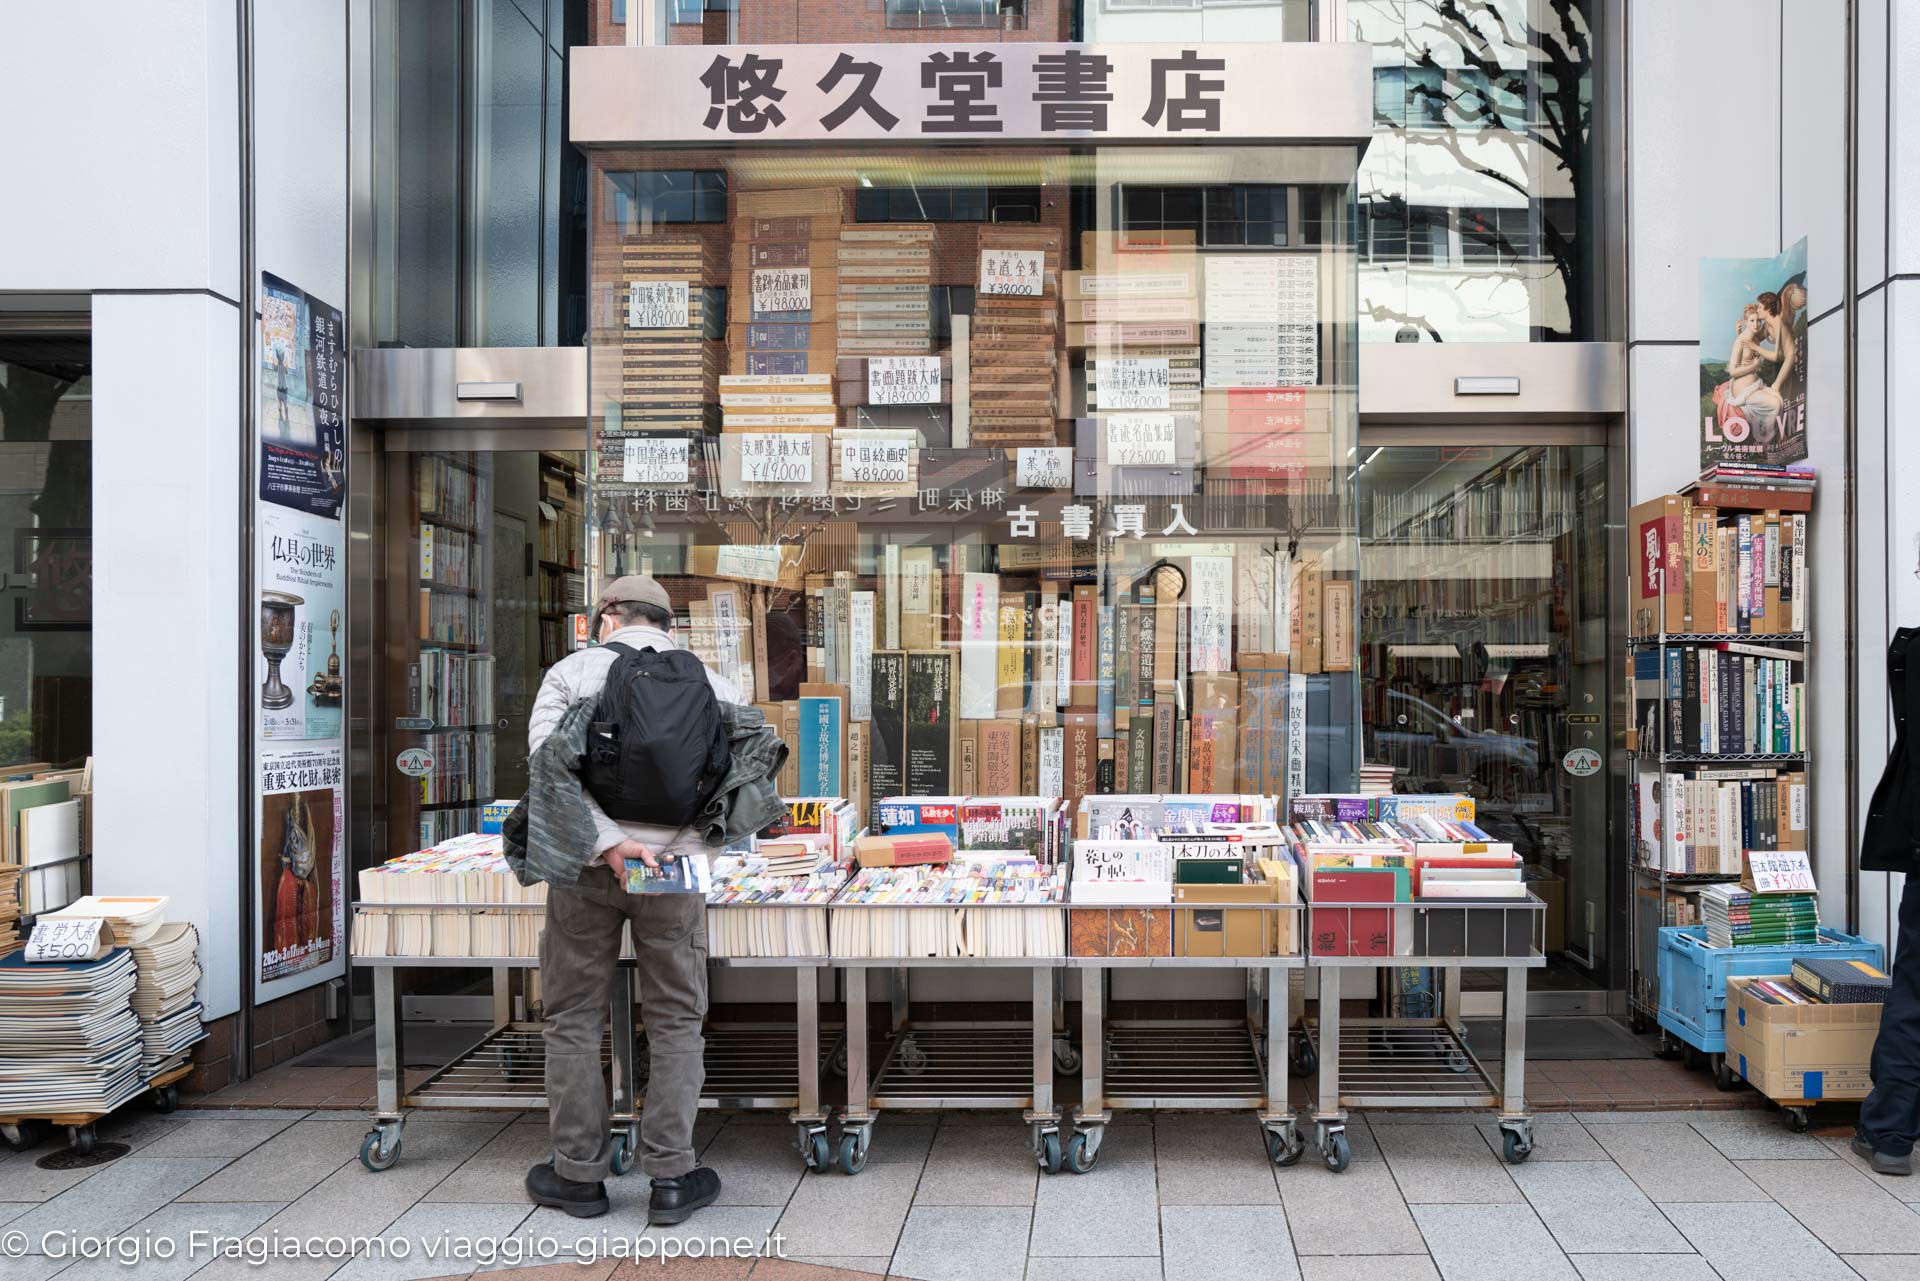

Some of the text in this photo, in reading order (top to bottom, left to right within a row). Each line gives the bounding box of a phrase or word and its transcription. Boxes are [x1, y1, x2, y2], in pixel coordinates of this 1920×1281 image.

[701, 53, 1226, 133] 悠久堂書店
[986, 258, 1039, 277] 書道全集
[315, 316, 330, 426] 銀河鉄道の夜
[846, 446, 908, 463] 中国絵画史
[852, 467, 904, 482] ¥89,000
[1007, 504, 1197, 538] 古書買入
[271, 535, 336, 571] 仏具の世界
[963, 746, 972, 772] 王羲之
[1000, 731, 1010, 791] 安宅コレクション
[1075, 728, 1087, 797] 故宮博物院
[881, 808, 915, 826] 蓮如
[922, 810, 955, 818] 仏教を歩く
[1164, 810, 1209, 823] 金閣寺
[1294, 804, 1325, 814] 鞍馬寺
[1172, 845, 1238, 859] 本刀の本
[1769, 873, 1808, 889] ¥500
[33, 922, 97, 943] 書学大系
[36, 943, 89, 960] ¥500
